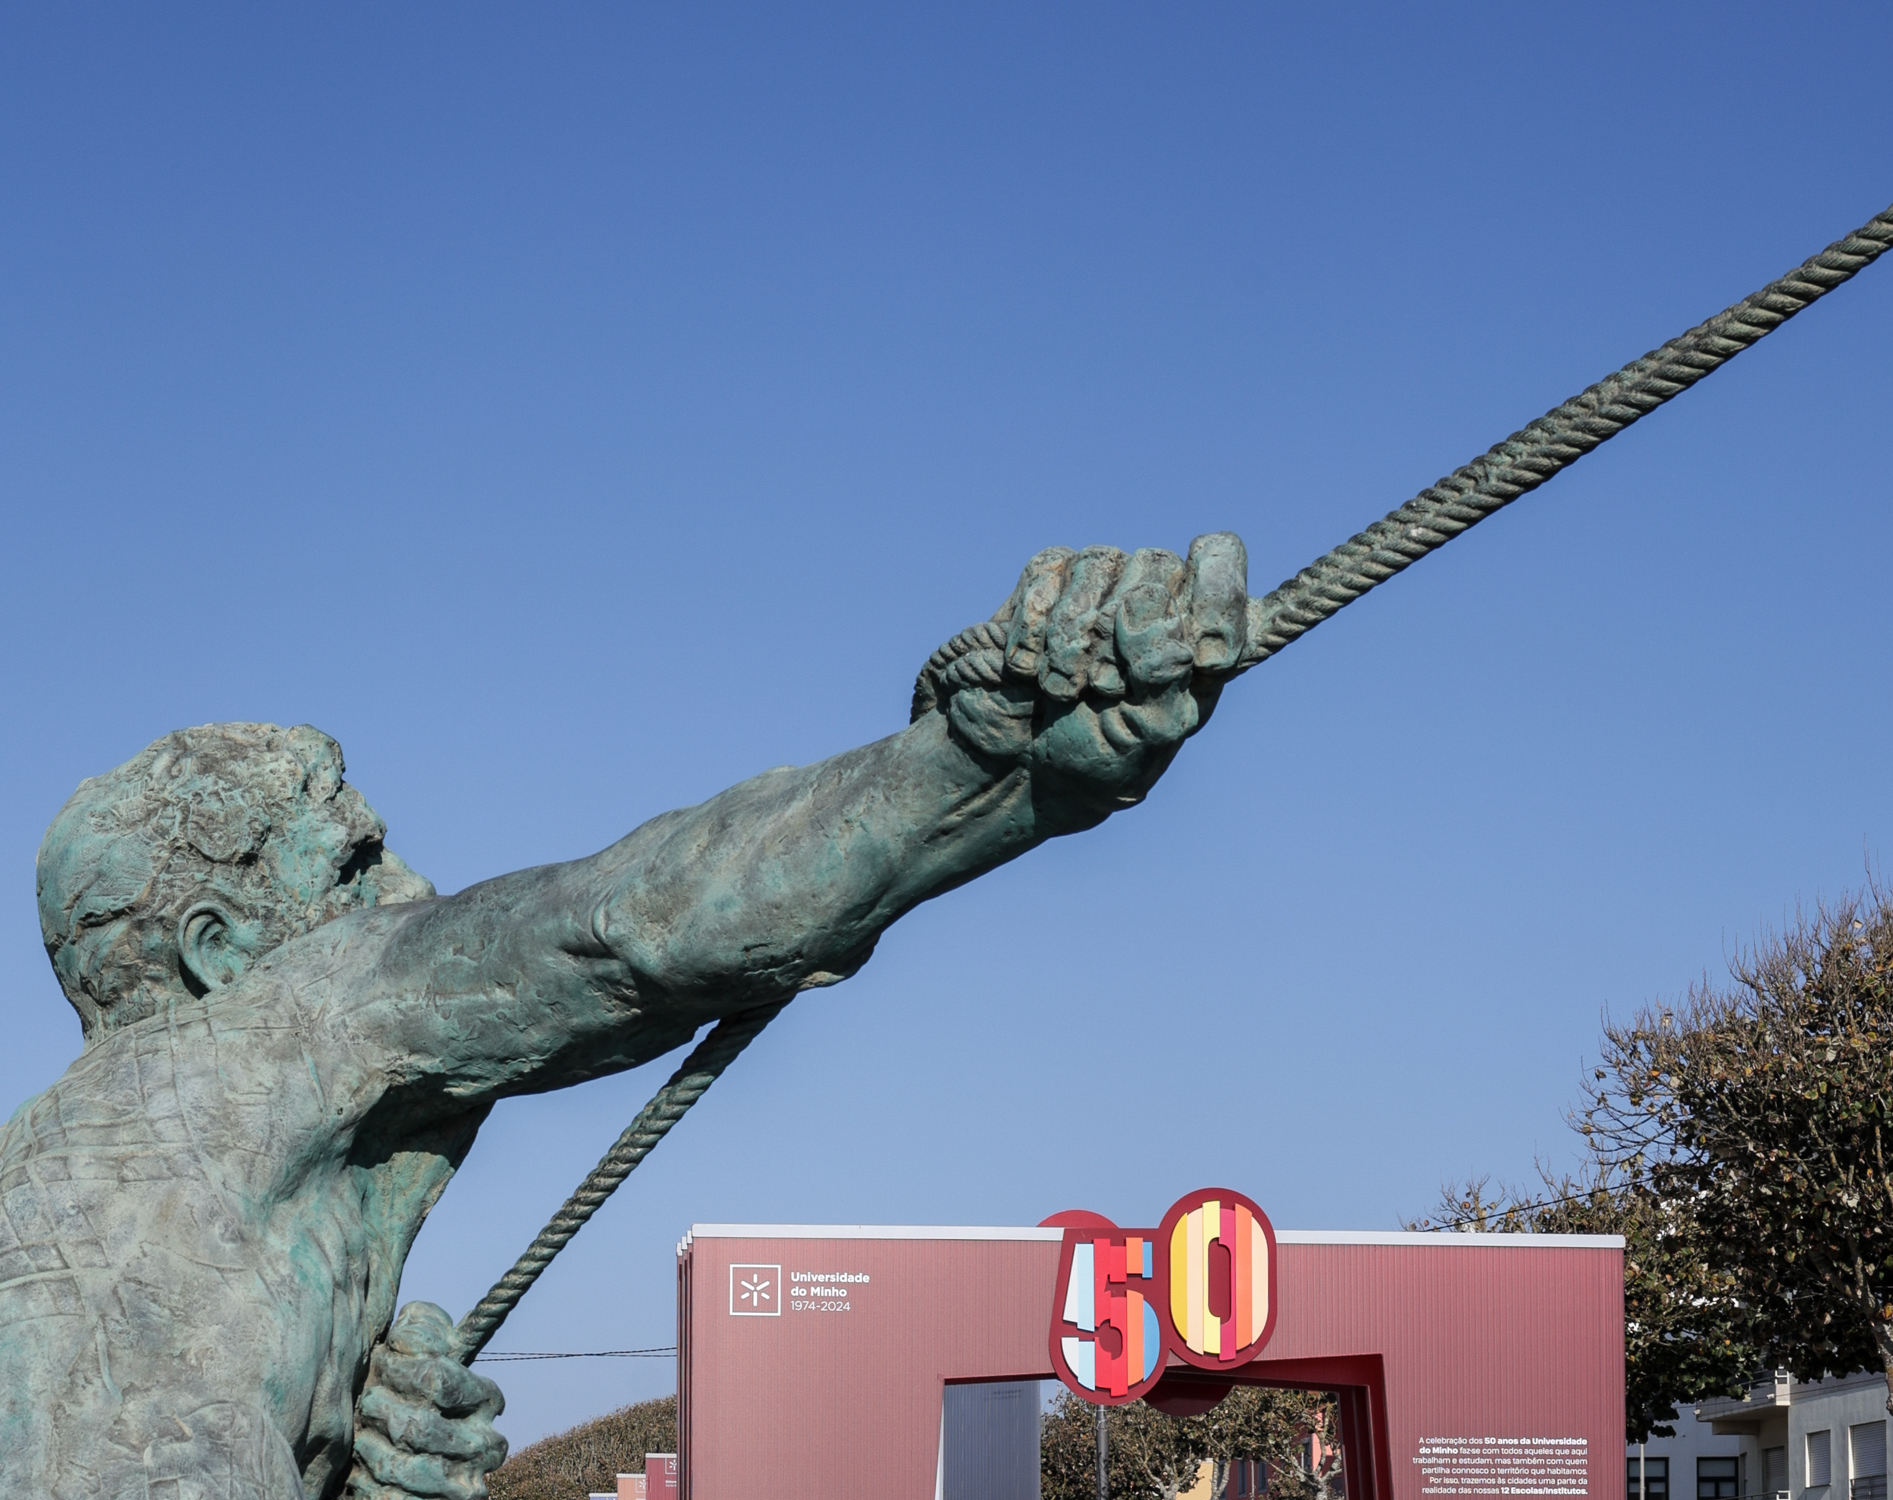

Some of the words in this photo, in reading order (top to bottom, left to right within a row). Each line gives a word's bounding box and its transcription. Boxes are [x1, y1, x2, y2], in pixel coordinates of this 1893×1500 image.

[791, 1272, 870, 1283] Universidade
[790, 1286, 807, 1296] do
[811, 1286, 847, 1297] Minho
[1061, 1200, 1268, 1396] 50
[791, 1300, 850, 1311] 1974-2024
[1419, 1437, 1425, 1447] A
[1426, 1437, 1467, 1448] celebração
[1469, 1437, 1483, 1446] dos
[1484, 1437, 1496, 1446] 50
[1498, 1438, 1518, 1447] anos
[1520, 1437, 1531, 1446] da
[1532, 1437, 1588, 1447] Universidade
[1419, 1446, 1431, 1454] do
[1432, 1446, 1458, 1454] Minho
[1524, 1448, 1553, 1456] aqueles
[1571, 1447, 1587, 1456] aqui
[1412, 1456, 1450, 1464] trabalham
[1512, 1456, 1545, 1465] também
[1546, 1456, 1564, 1465] com
[1565, 1456, 1588, 1466] quem
[1422, 1467, 1450, 1475] partilha
[1531, 1468, 1545, 1476] que
[1547, 1466, 1588, 1475] habitamos.
[1430, 1476, 1442, 1484] Por
[1507, 1476, 1537, 1484] cidades
[1557, 1477, 1576, 1486] parte
[1422, 1486, 1456, 1494] realidade
[1511, 1486, 1588, 1494] Escolas/Institutos.
